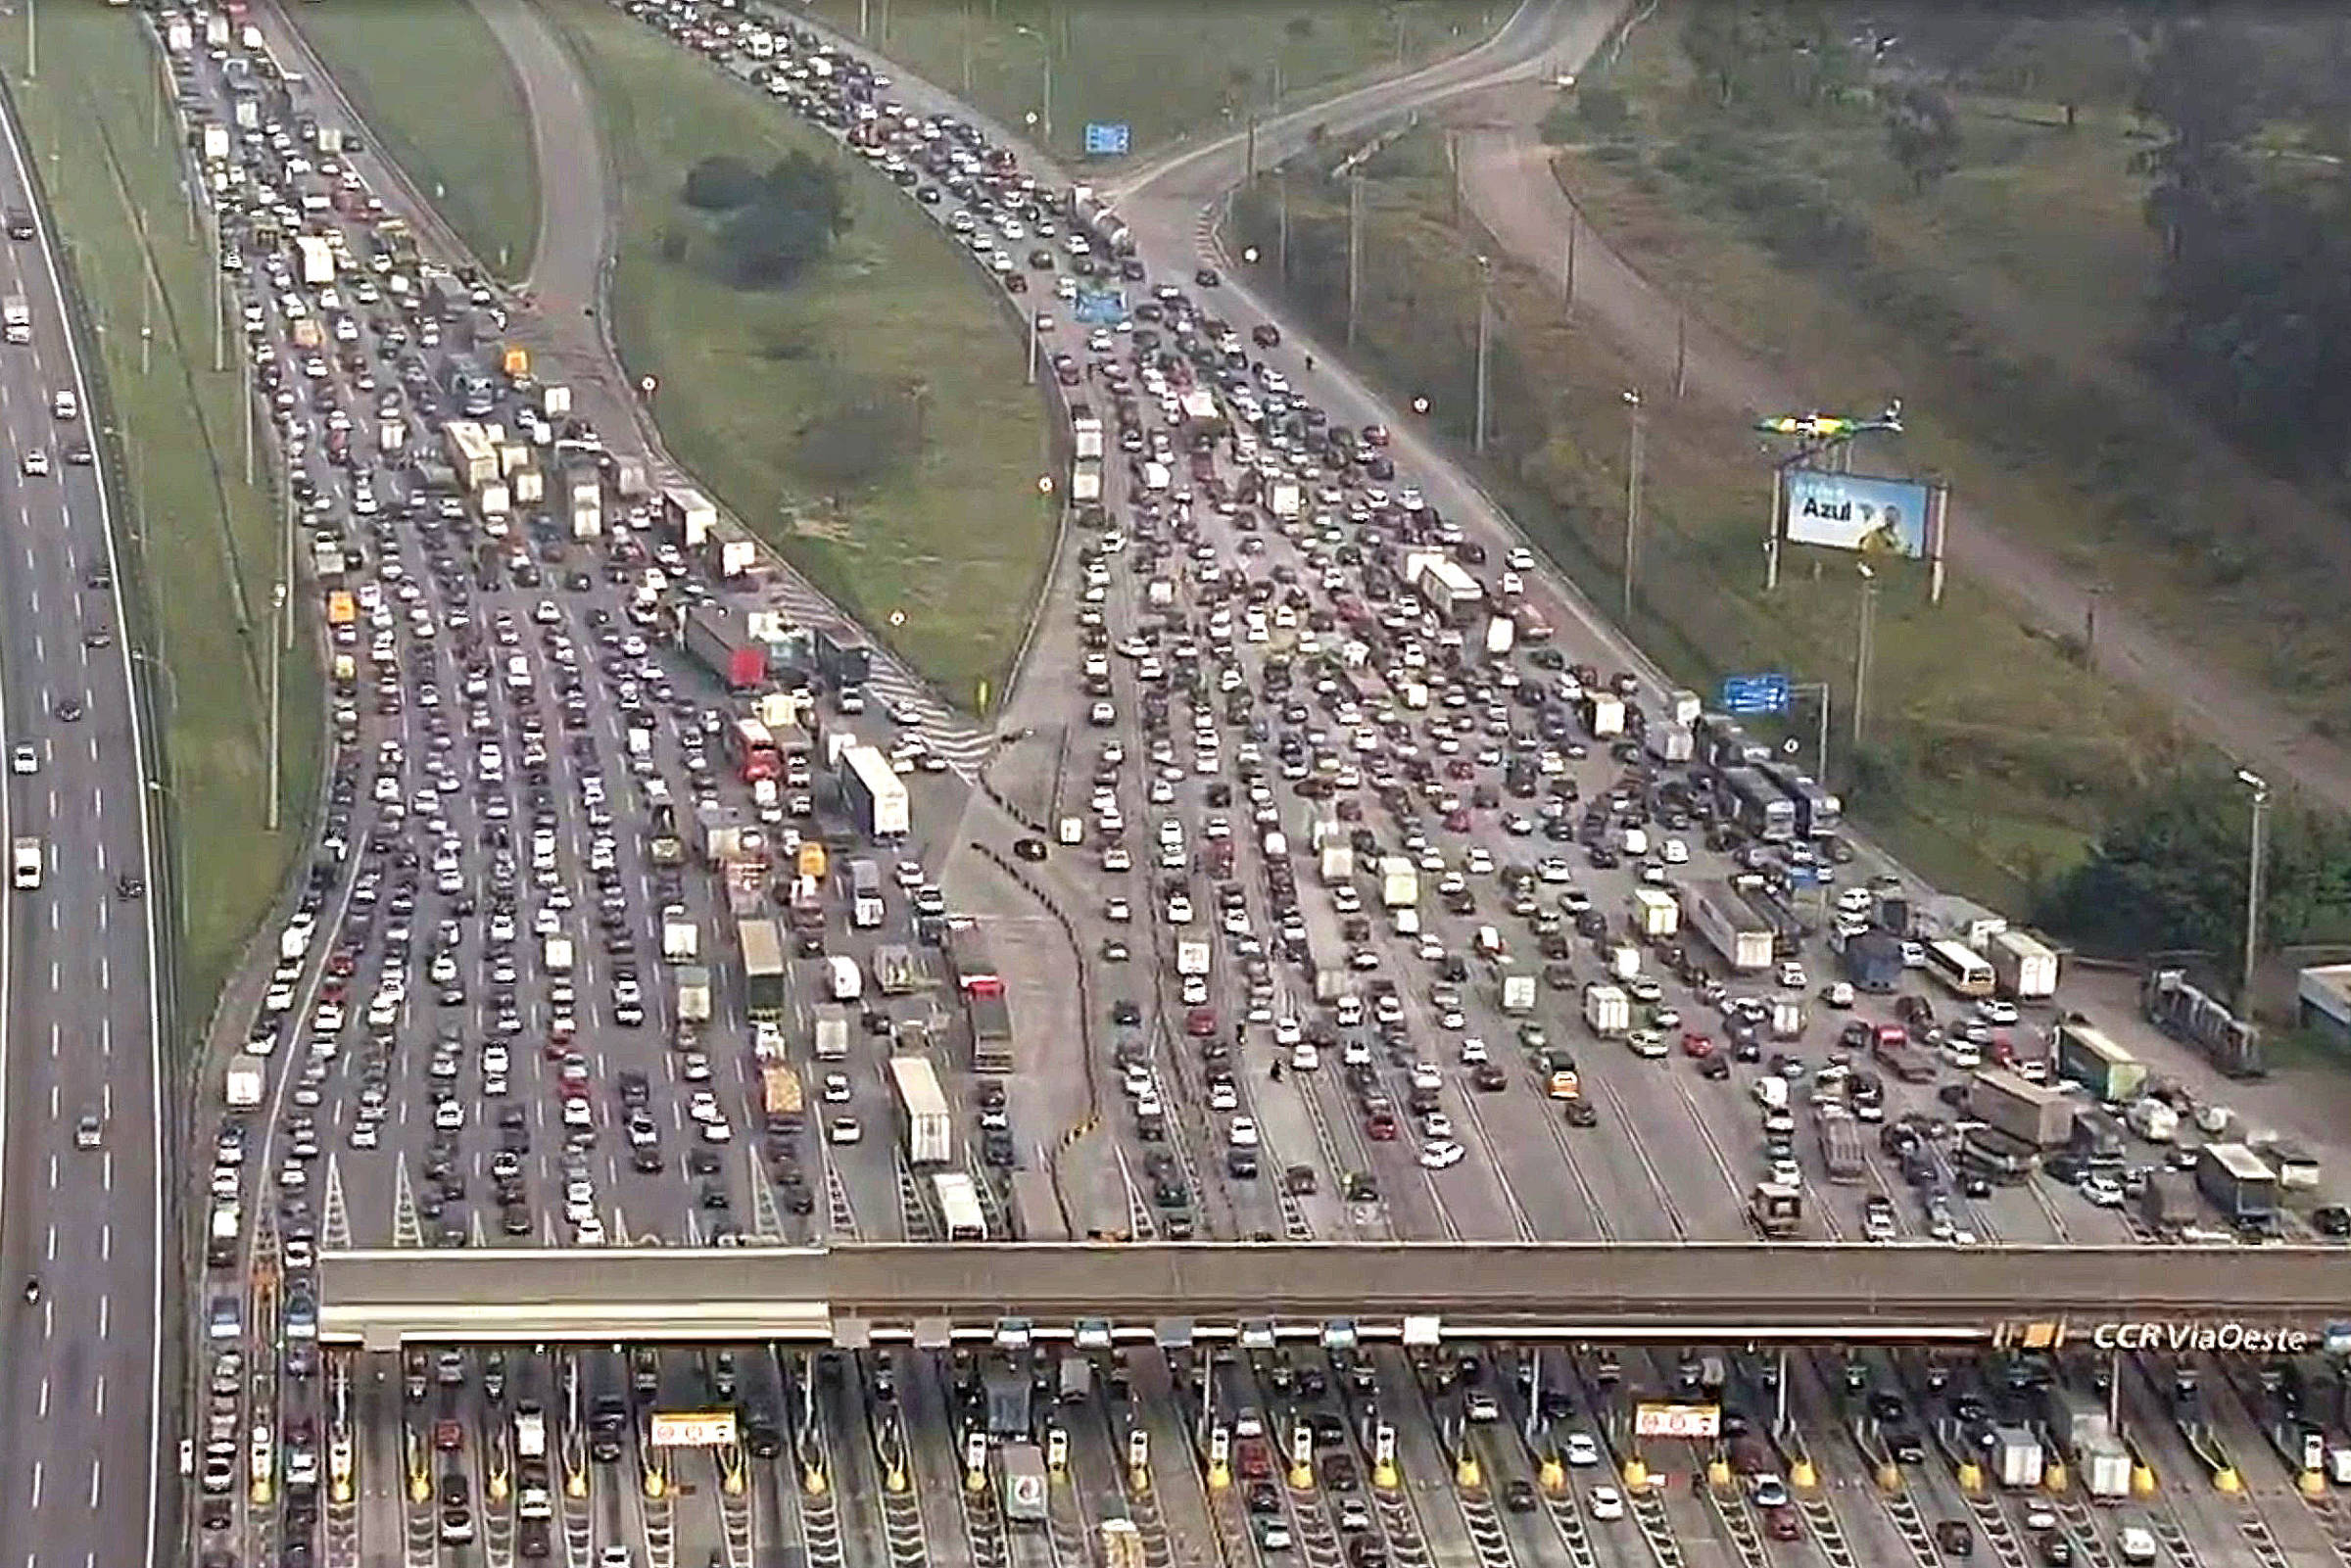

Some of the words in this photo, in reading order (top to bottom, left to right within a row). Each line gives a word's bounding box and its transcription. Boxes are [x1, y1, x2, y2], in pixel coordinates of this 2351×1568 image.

[1803, 497, 1851, 522] Azul
[2093, 1323, 2161, 1350] CCR
[2167, 1322, 2309, 1352] ViaOeste
